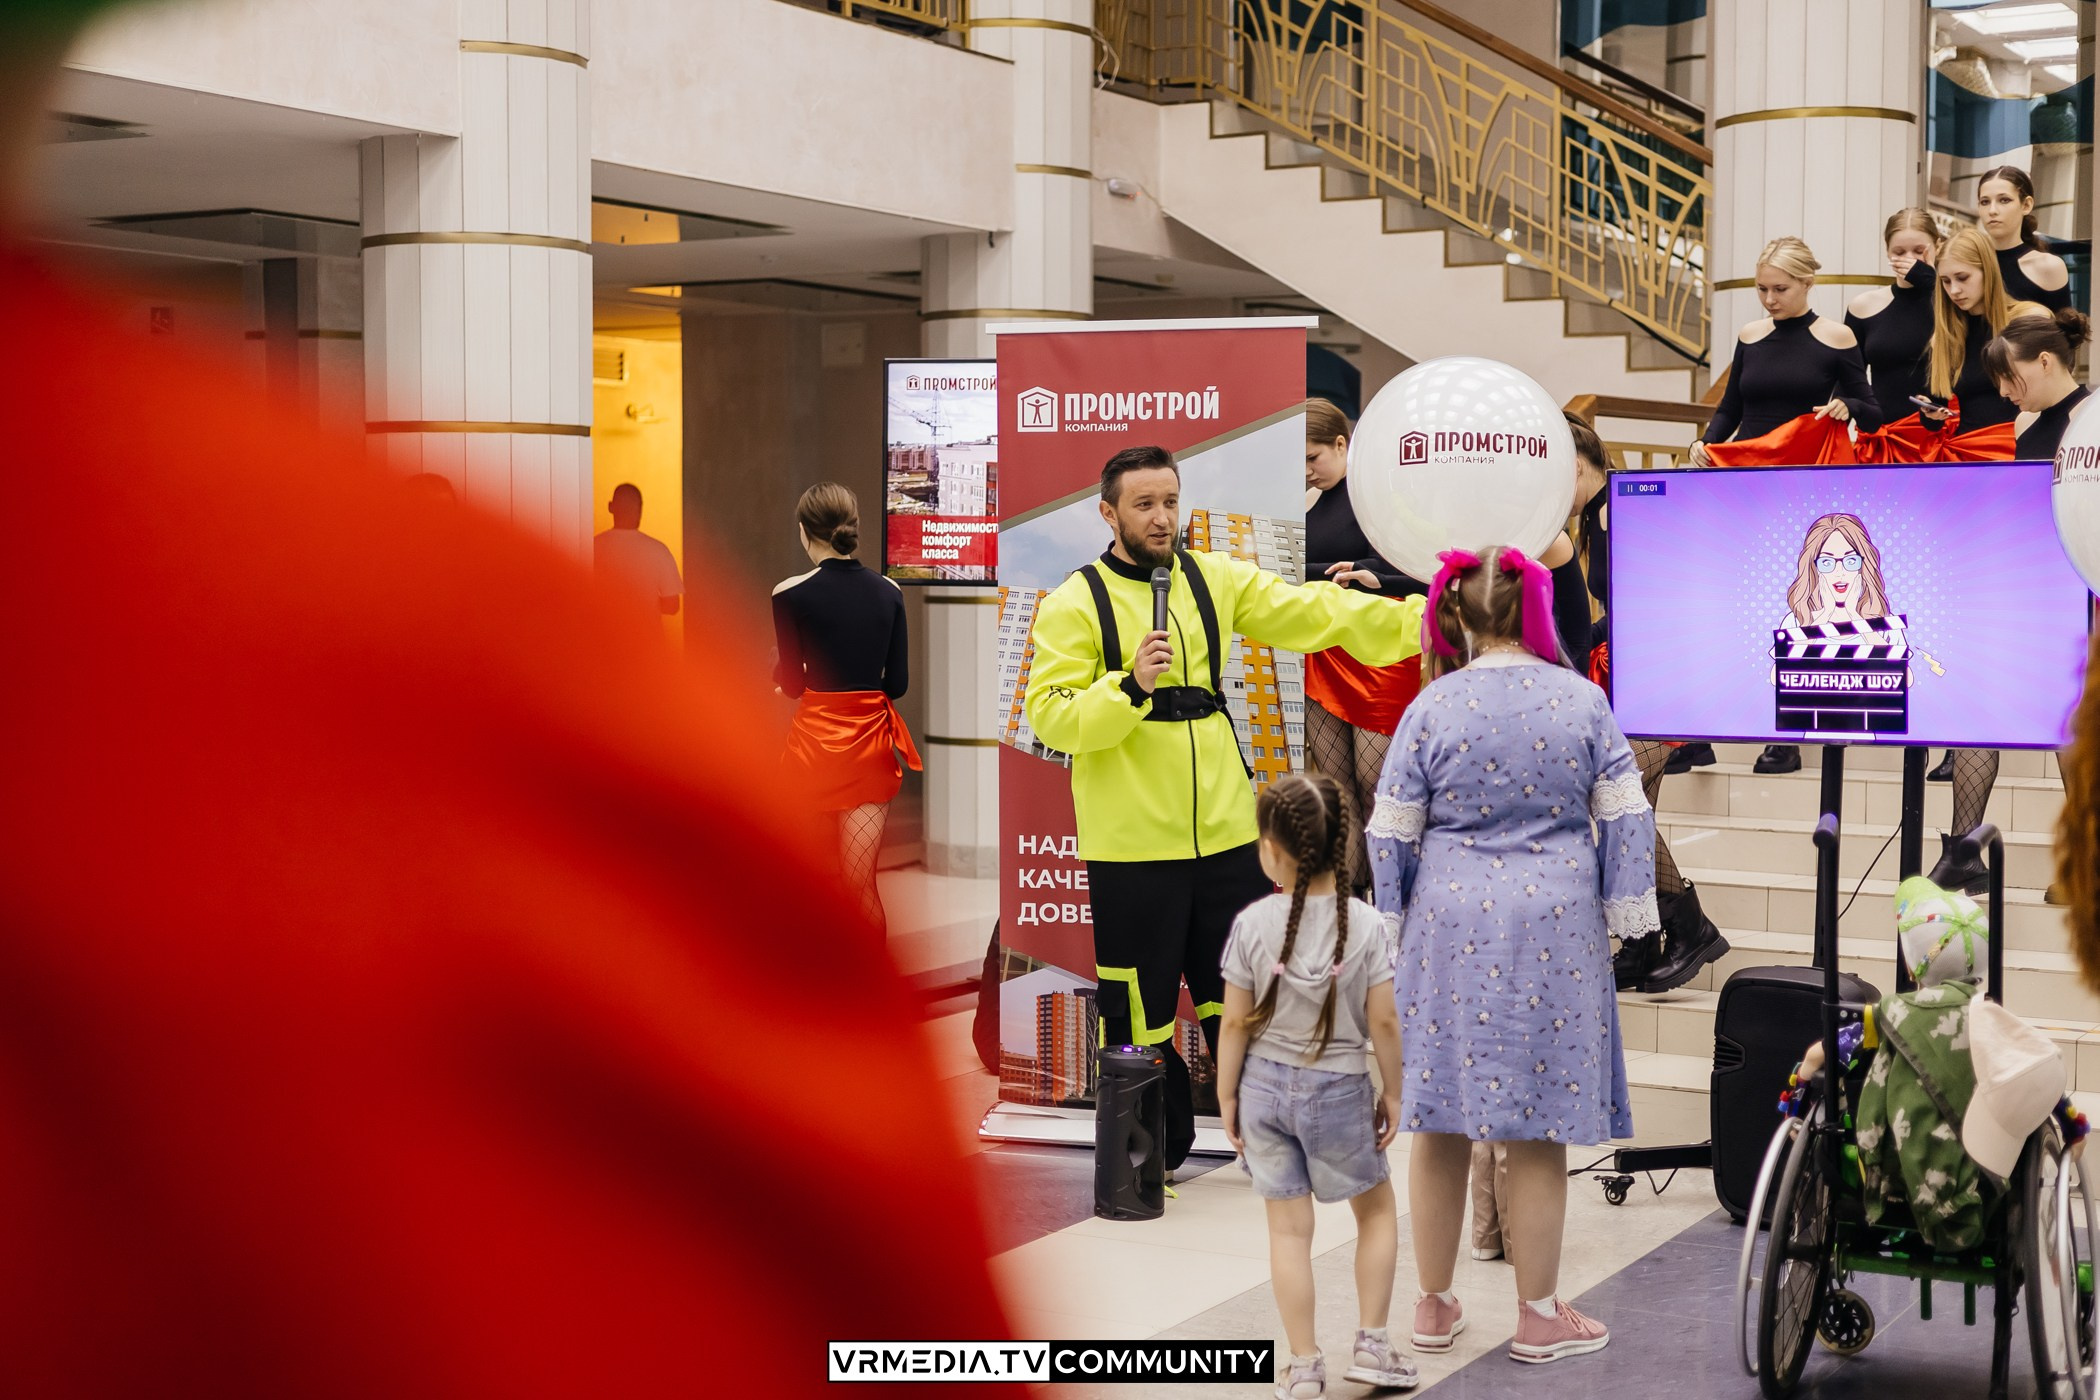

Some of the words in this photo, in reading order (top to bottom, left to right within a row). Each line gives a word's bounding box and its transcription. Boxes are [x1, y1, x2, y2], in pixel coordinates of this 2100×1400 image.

[924, 375, 997, 391] ПРОМСТРОЙ
[1064, 385, 1219, 421] ПРОМСТРОЙ
[1064, 423, 1128, 432] КОМПАНИЯ
[1434, 431, 1548, 459] ПРОМСТРОЙ
[1434, 456, 1495, 465] КОМПАНИЯ
[1639, 484, 1658, 492] 00:01
[922, 534, 972, 549] комфорт
[922, 549, 959, 560] класса
[1780, 674, 1863, 690] ЧЕЛЛЕНДЖ
[1866, 675, 1902, 689] ШОУ
[1018, 869, 1090, 890] КАЧЕ
[1017, 902, 1094, 926] ДОВЕ
